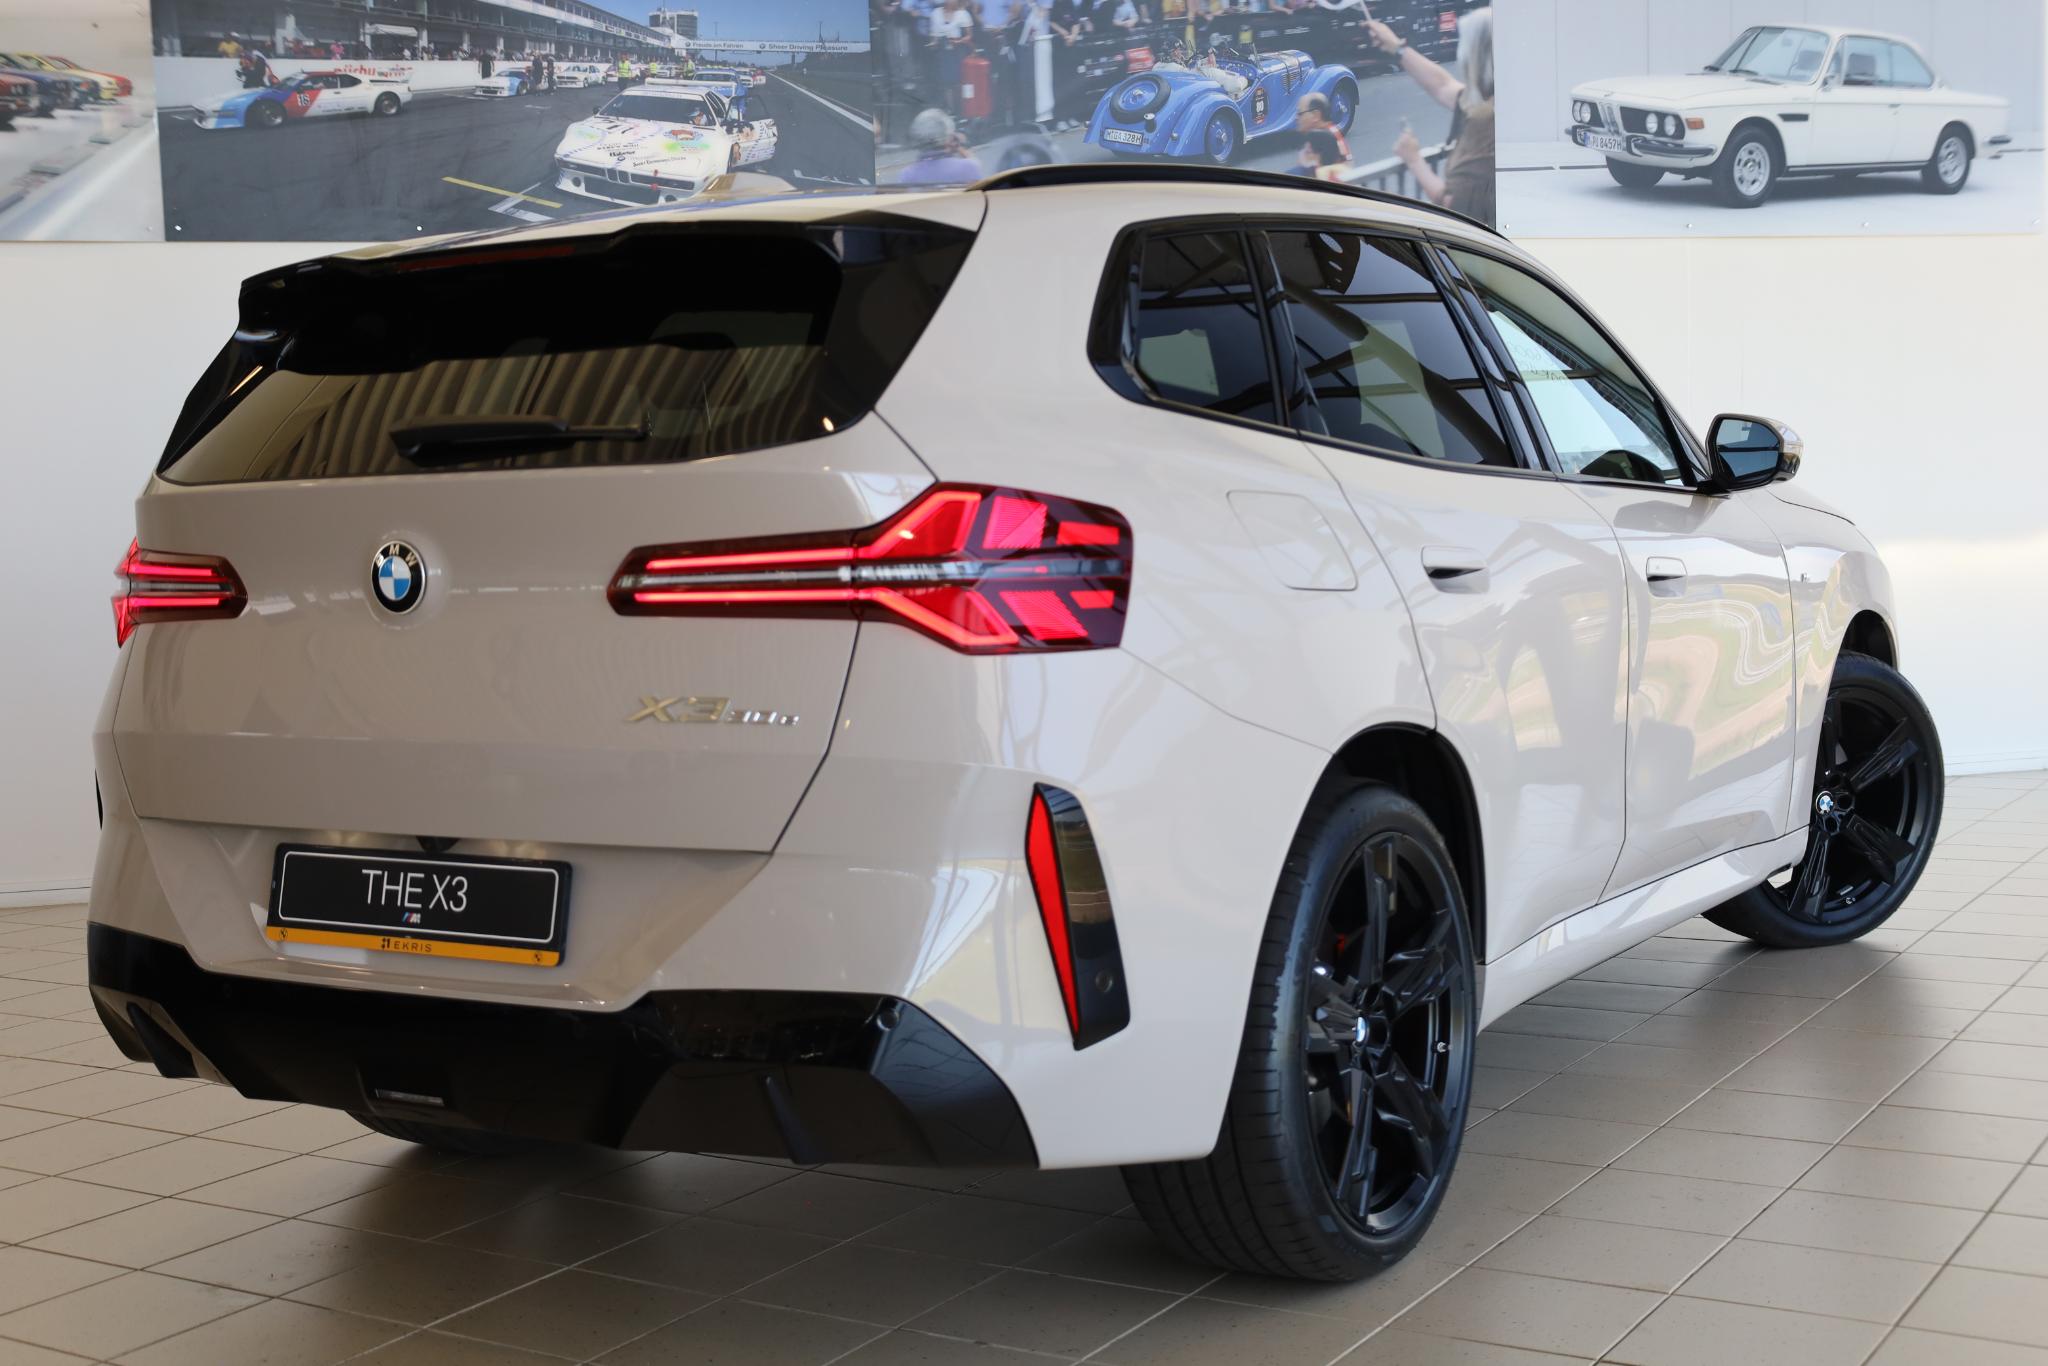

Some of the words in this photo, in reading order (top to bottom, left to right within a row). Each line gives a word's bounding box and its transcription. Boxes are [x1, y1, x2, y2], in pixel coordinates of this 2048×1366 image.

[789, 43, 814, 51] Driving
[375, 543, 417, 568] BMW
[623, 696, 730, 723] X3
[362, 869, 424, 908] THE
[429, 874, 468, 912] X3
[394, 940, 432, 952] EKRIS
